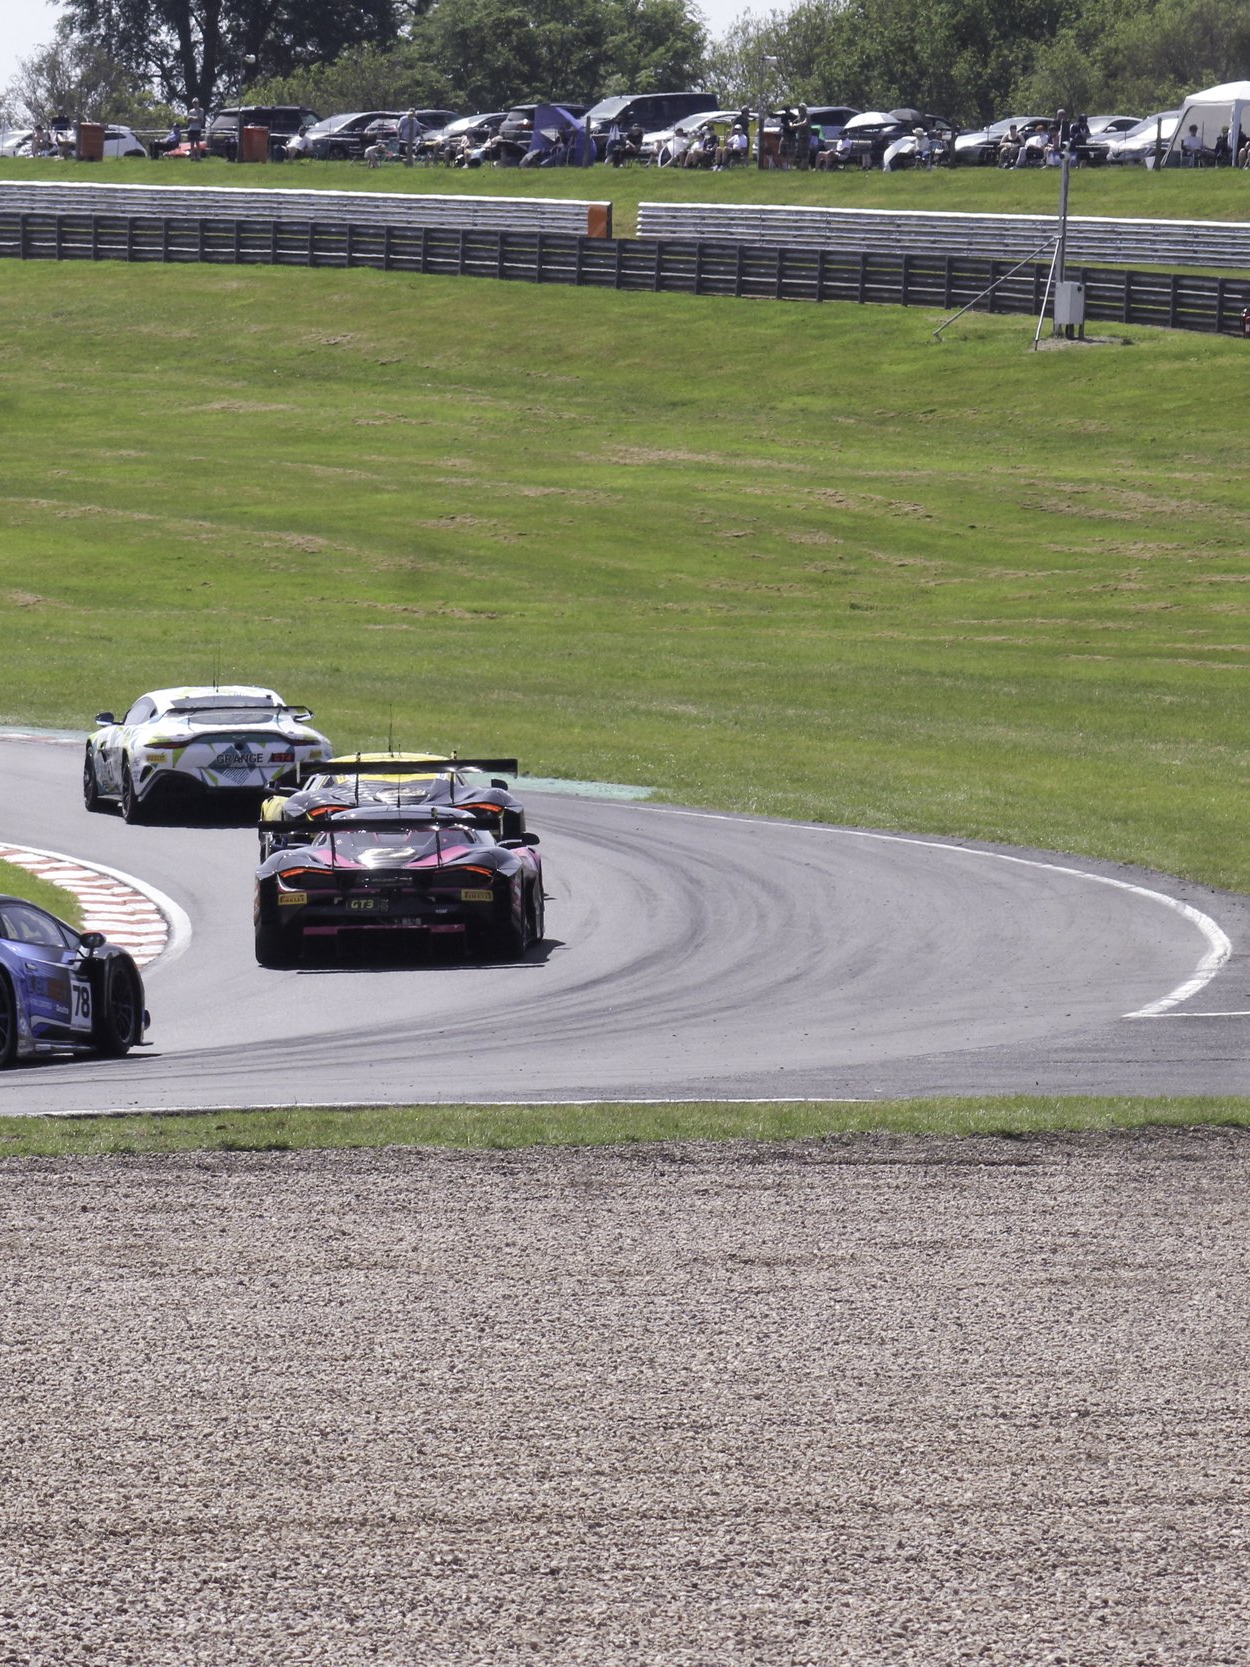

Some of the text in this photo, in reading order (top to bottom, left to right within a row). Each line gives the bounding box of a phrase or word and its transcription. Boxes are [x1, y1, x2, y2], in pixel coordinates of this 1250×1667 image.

[216, 753, 264, 764] GRANGE
[350, 899, 374, 909] GT3
[72, 984, 90, 1018] 78
